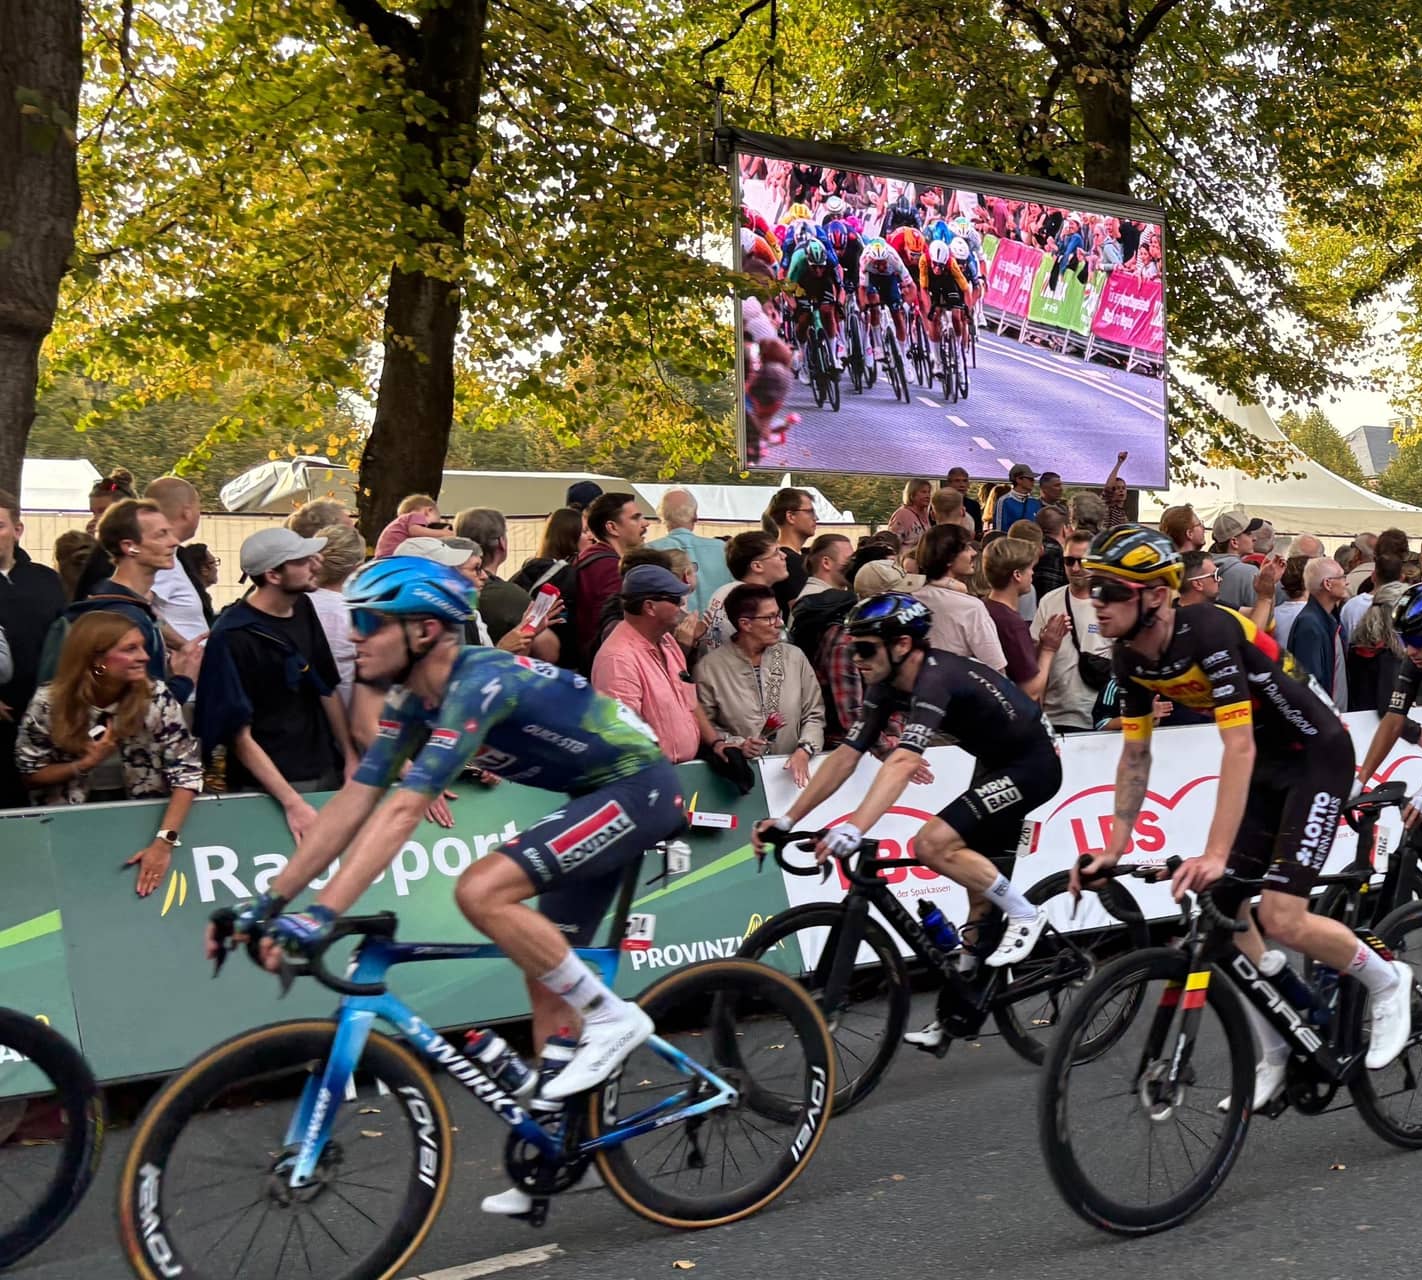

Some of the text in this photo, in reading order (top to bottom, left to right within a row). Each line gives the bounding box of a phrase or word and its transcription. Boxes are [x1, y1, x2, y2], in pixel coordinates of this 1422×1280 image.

[974, 775, 1016, 798] MRW
[982, 792, 1022, 813] BAU
[561, 812, 634, 869] SOUDAL
[1300, 791, 1331, 848] LOTTO
[896, 885, 951, 898] der Sparkassen
[1232, 954, 1323, 1053] DARE
[405, 1014, 526, 1126] S-WORKS
